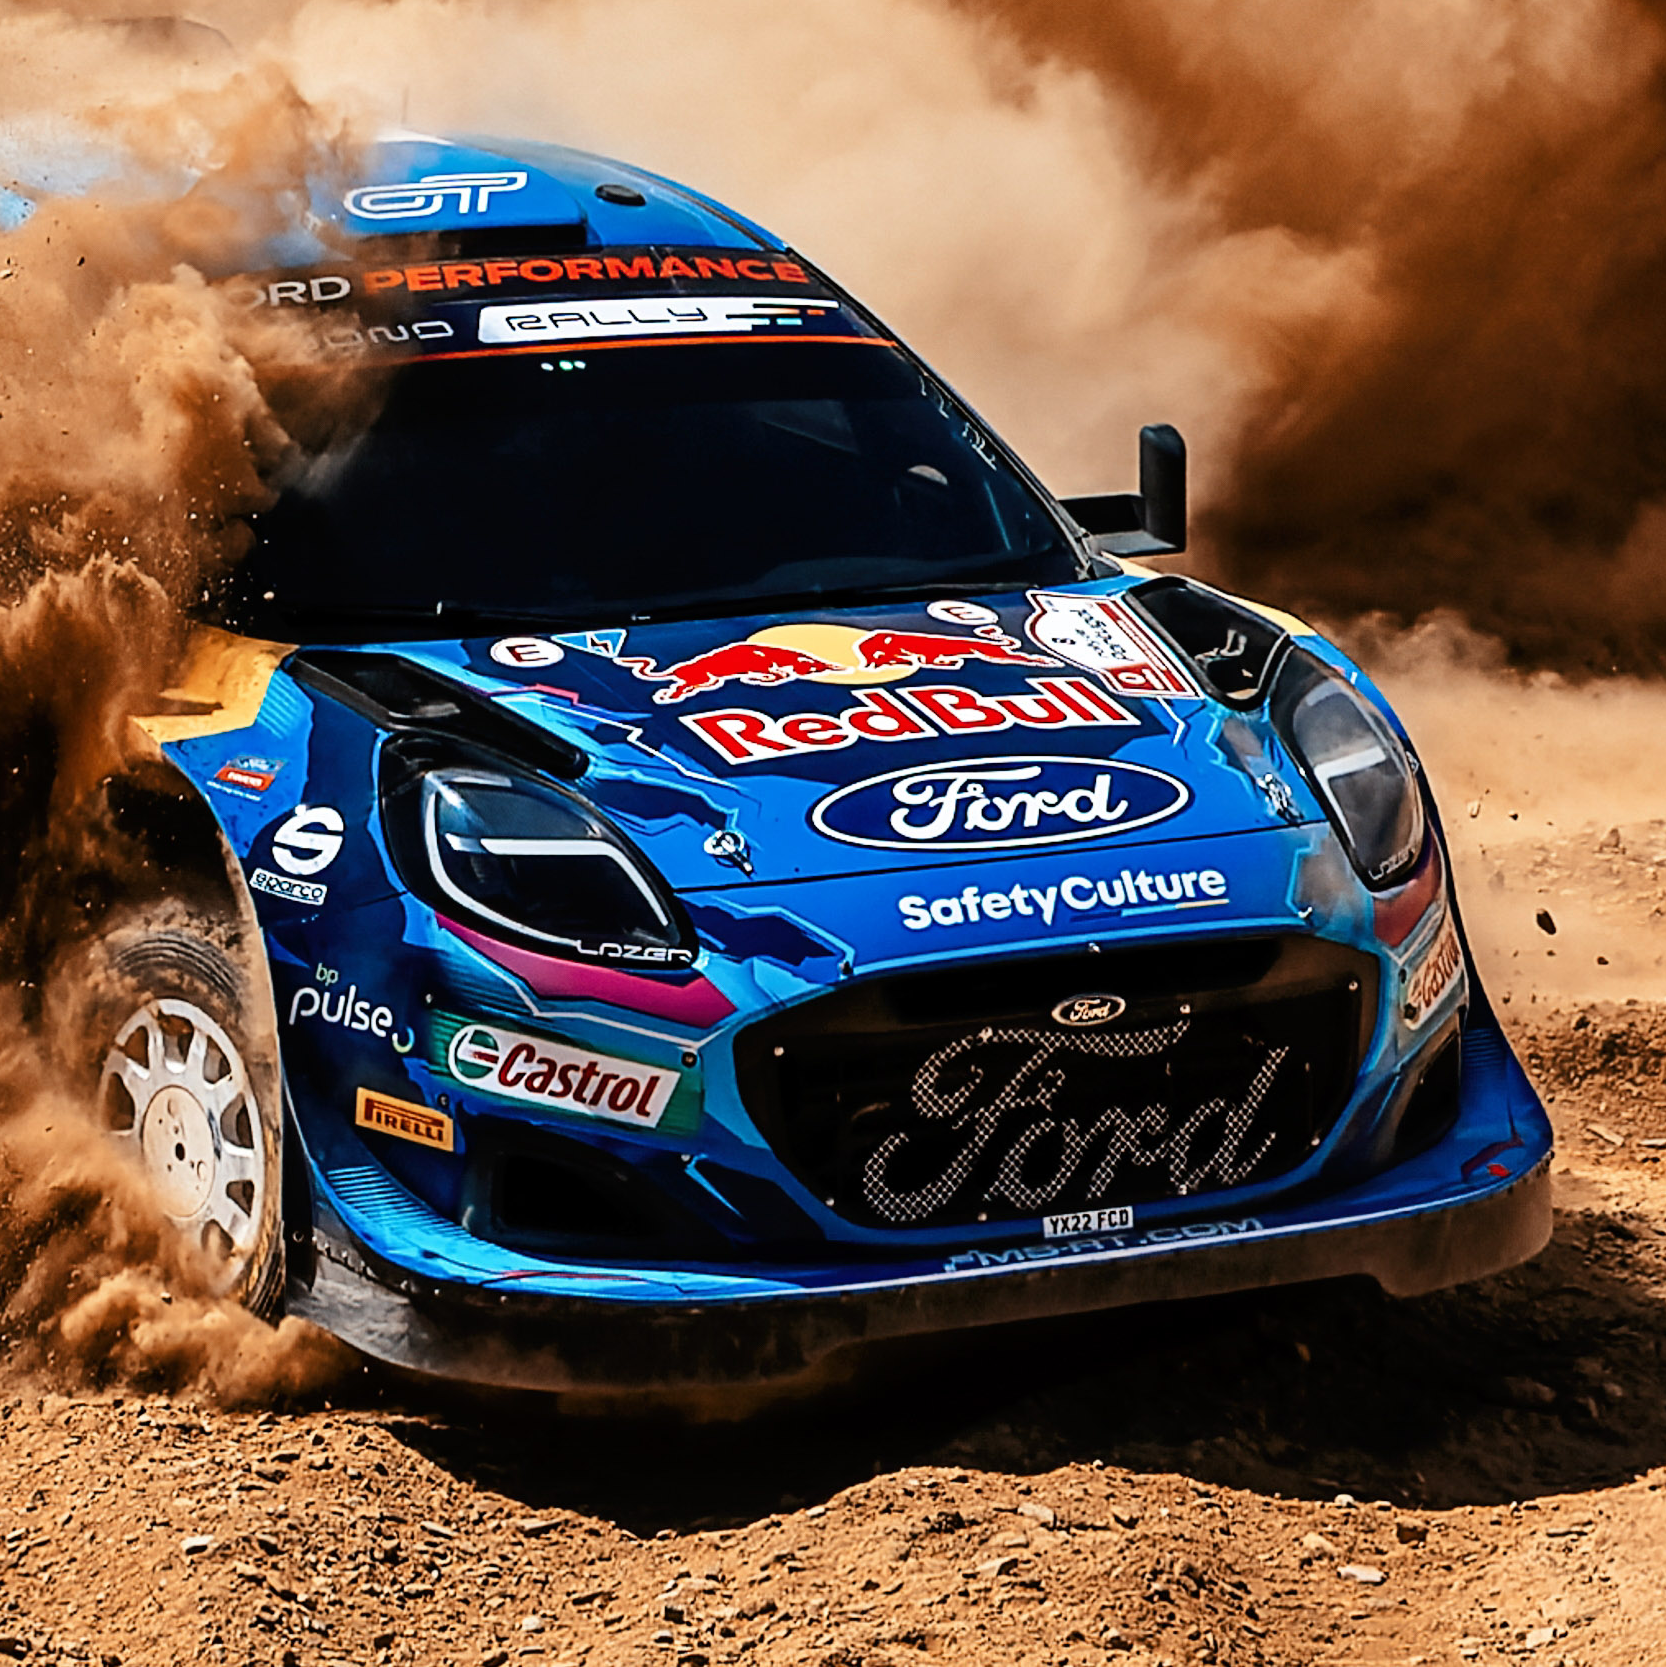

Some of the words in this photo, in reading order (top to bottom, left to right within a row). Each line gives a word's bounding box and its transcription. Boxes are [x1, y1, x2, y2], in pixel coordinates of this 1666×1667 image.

[343, 170, 528, 221] GT
[363, 255, 810, 294] PERFORMANCE
[504, 307, 709, 332] RALLY
[504, 643, 550, 663] E
[688, 686, 932, 762] Red
[906, 676, 1129, 733] Bull
[890, 764, 1129, 840] Ford
[897, 868, 1228, 931] SafetyCulture
[316, 962, 339, 986] bp
[288, 985, 393, 1038] pulse
[1068, 999, 1112, 1022] Ford
[497, 1043, 662, 1118] Castrol
[364, 1097, 445, 1143] PIRELLI
[862, 1020, 1290, 1222] Ford
[1049, 1214, 1092, 1234] YX22
